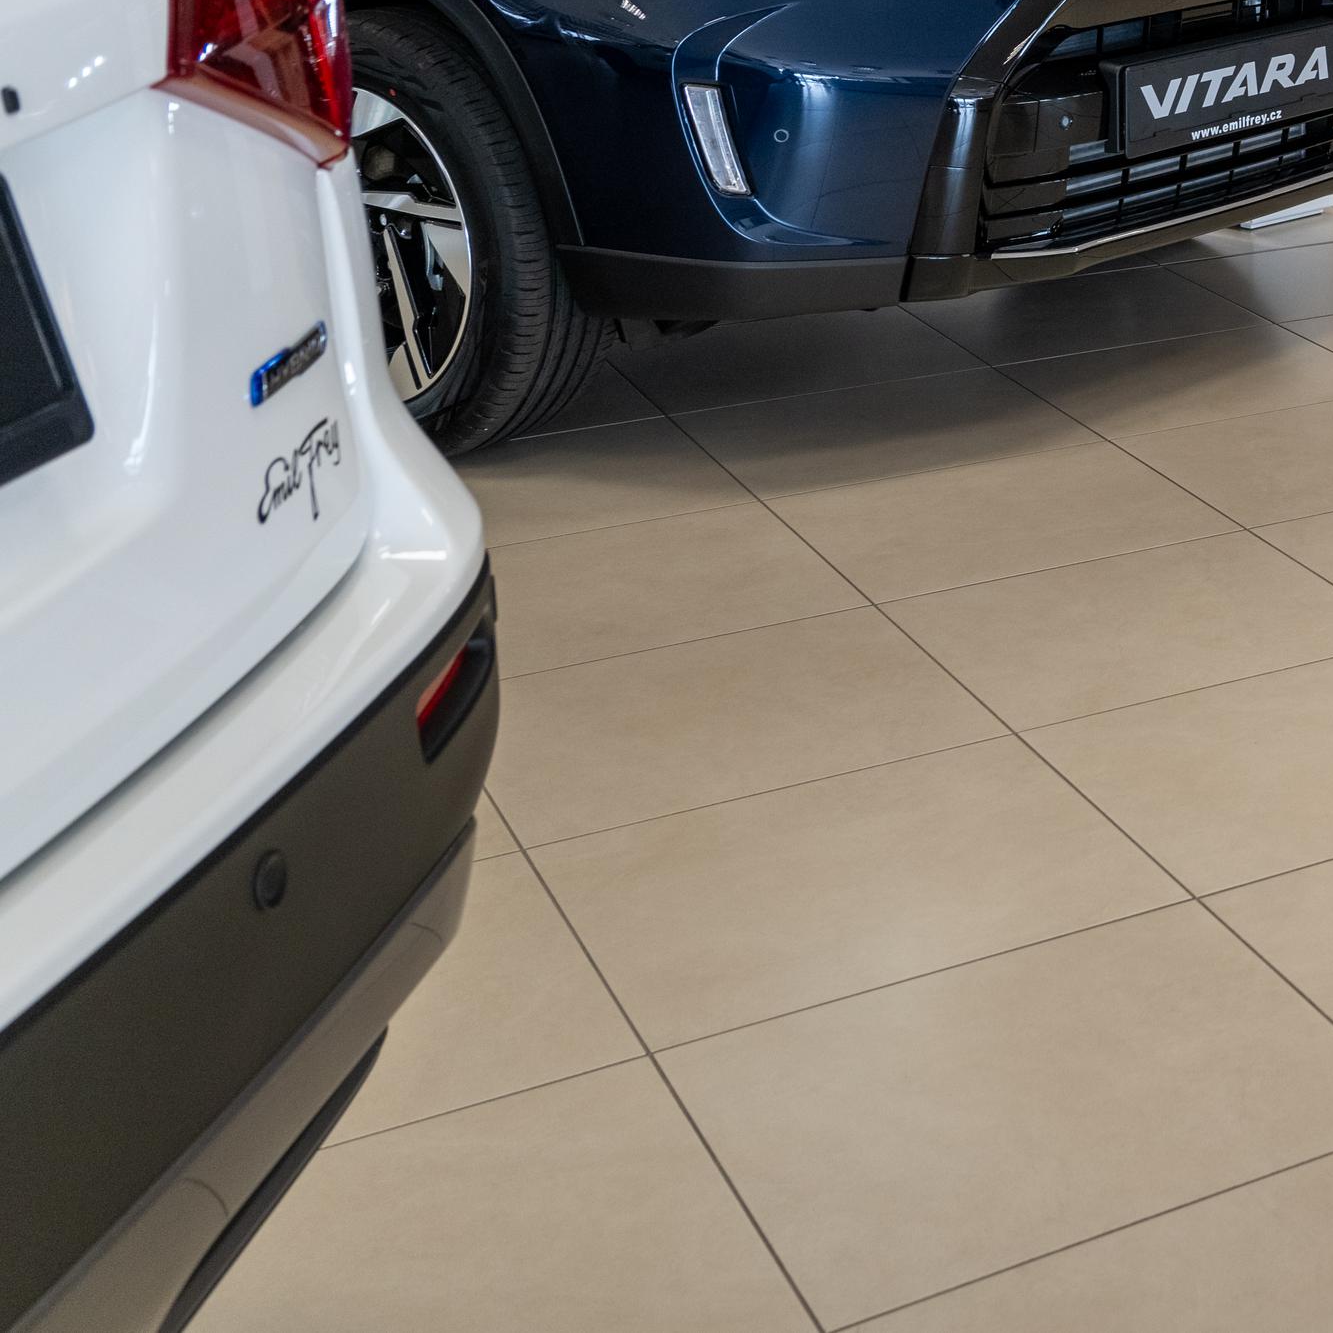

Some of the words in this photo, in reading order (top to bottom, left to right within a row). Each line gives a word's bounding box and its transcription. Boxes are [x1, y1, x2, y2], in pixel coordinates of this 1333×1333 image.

[1140, 45, 1330, 120] VITARA
[1191, 109, 1283, 141] www.emilfrey.cz
[258, 446, 303, 525] Emil
[299, 417, 342, 521] Frey
